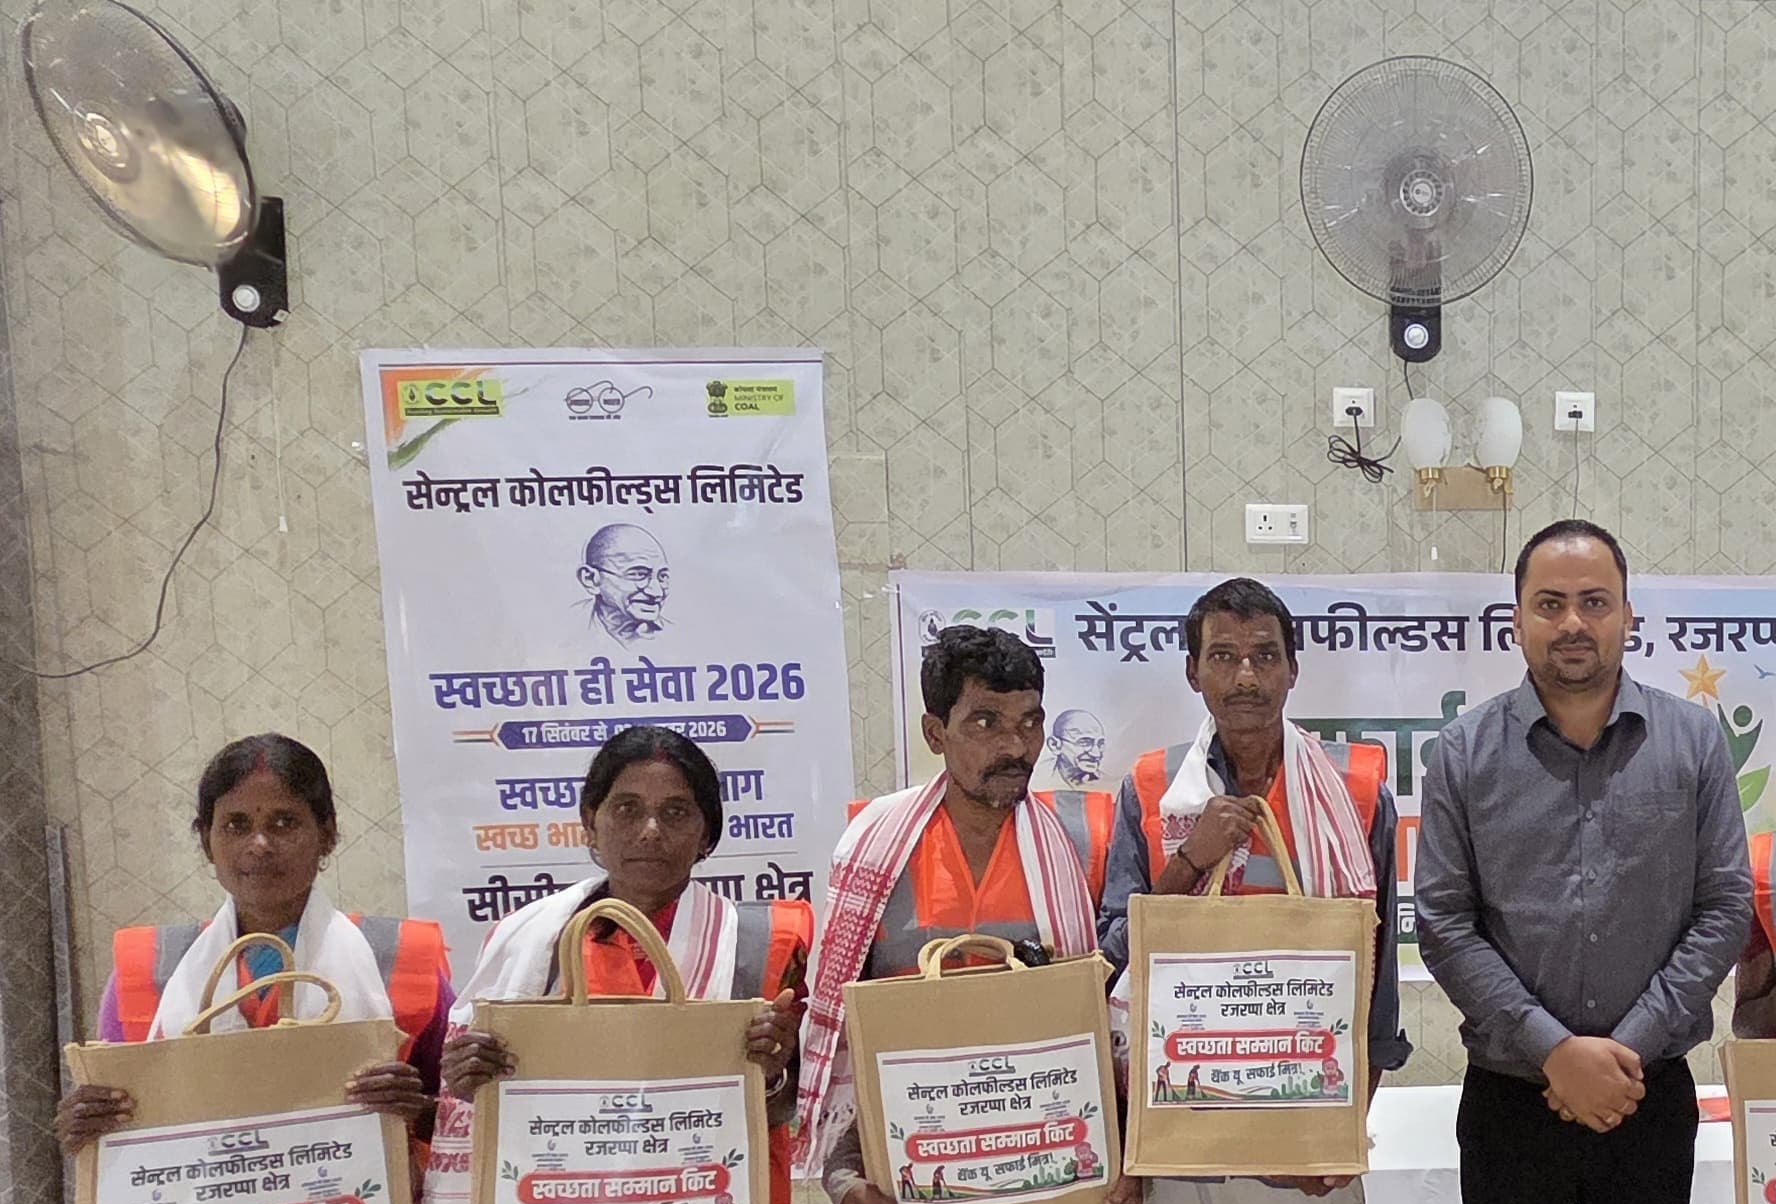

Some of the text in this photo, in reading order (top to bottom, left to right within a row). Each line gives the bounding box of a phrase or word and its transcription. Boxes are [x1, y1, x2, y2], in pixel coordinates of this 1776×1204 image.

[424, 381, 497, 406] CCL
[734, 402, 760, 411] COAL
[402, 463, 804, 514] सेन्ट्रल कोलफील्ड्स लिमिटेड
[1074, 601, 1188, 662] सेंट्रल
[429, 655, 805, 710] स्वच्छता ही सेवा 2026
[522, 726, 537, 744] 17
[540, 722, 590, 743] सितंबर
[593, 720, 608, 742] से
[472, 824, 540, 852] स्वच्छ
[728, 812, 795, 840] भारत
[1242, 960, 1274, 976] CCL
[1174, 982, 1213, 1000] सेन्ट्रल
[1286, 978, 1334, 998] लिमिटेड
[1220, 998, 1287, 1018] रजरप्पा क्षेत्र
[1175, 1030, 1325, 1056] स्वच्छता सम्मान किट
[979, 1056, 1016, 1072] CCL
[1232, 1069, 1245, 1086] यू
[1246, 1063, 1276, 1080] सफाई
[906, 1082, 949, 1102] सेन्ट्रल
[1029, 1067, 1078, 1090] लिमिटेड
[612, 1094, 653, 1109] CCL
[958, 1097, 1007, 1116] रजरप्पा
[1009, 1092, 1032, 1111] क्षेत्र
[529, 1115, 575, 1137] सेन्ट्रल
[668, 1109, 723, 1131] लिमिटेड
[221, 1130, 269, 1149] CCL
[584, 1136, 669, 1156] रजरप्पा क्षेत्र
[916, 1121, 1076, 1158] स्वच्छता सम्मान किट
[131, 1166, 182, 1187] सेन्ट्रल
[287, 1140, 353, 1167] लिमिटेड
[979, 1165, 993, 1182] यू
[994, 1157, 1026, 1176] सफाई
[196, 1178, 257, 1202] रजरप्पा
[262, 1173, 291, 1194] क्षेत्र
[531, 1167, 718, 1200] स्वच्छता सम्मान किट
